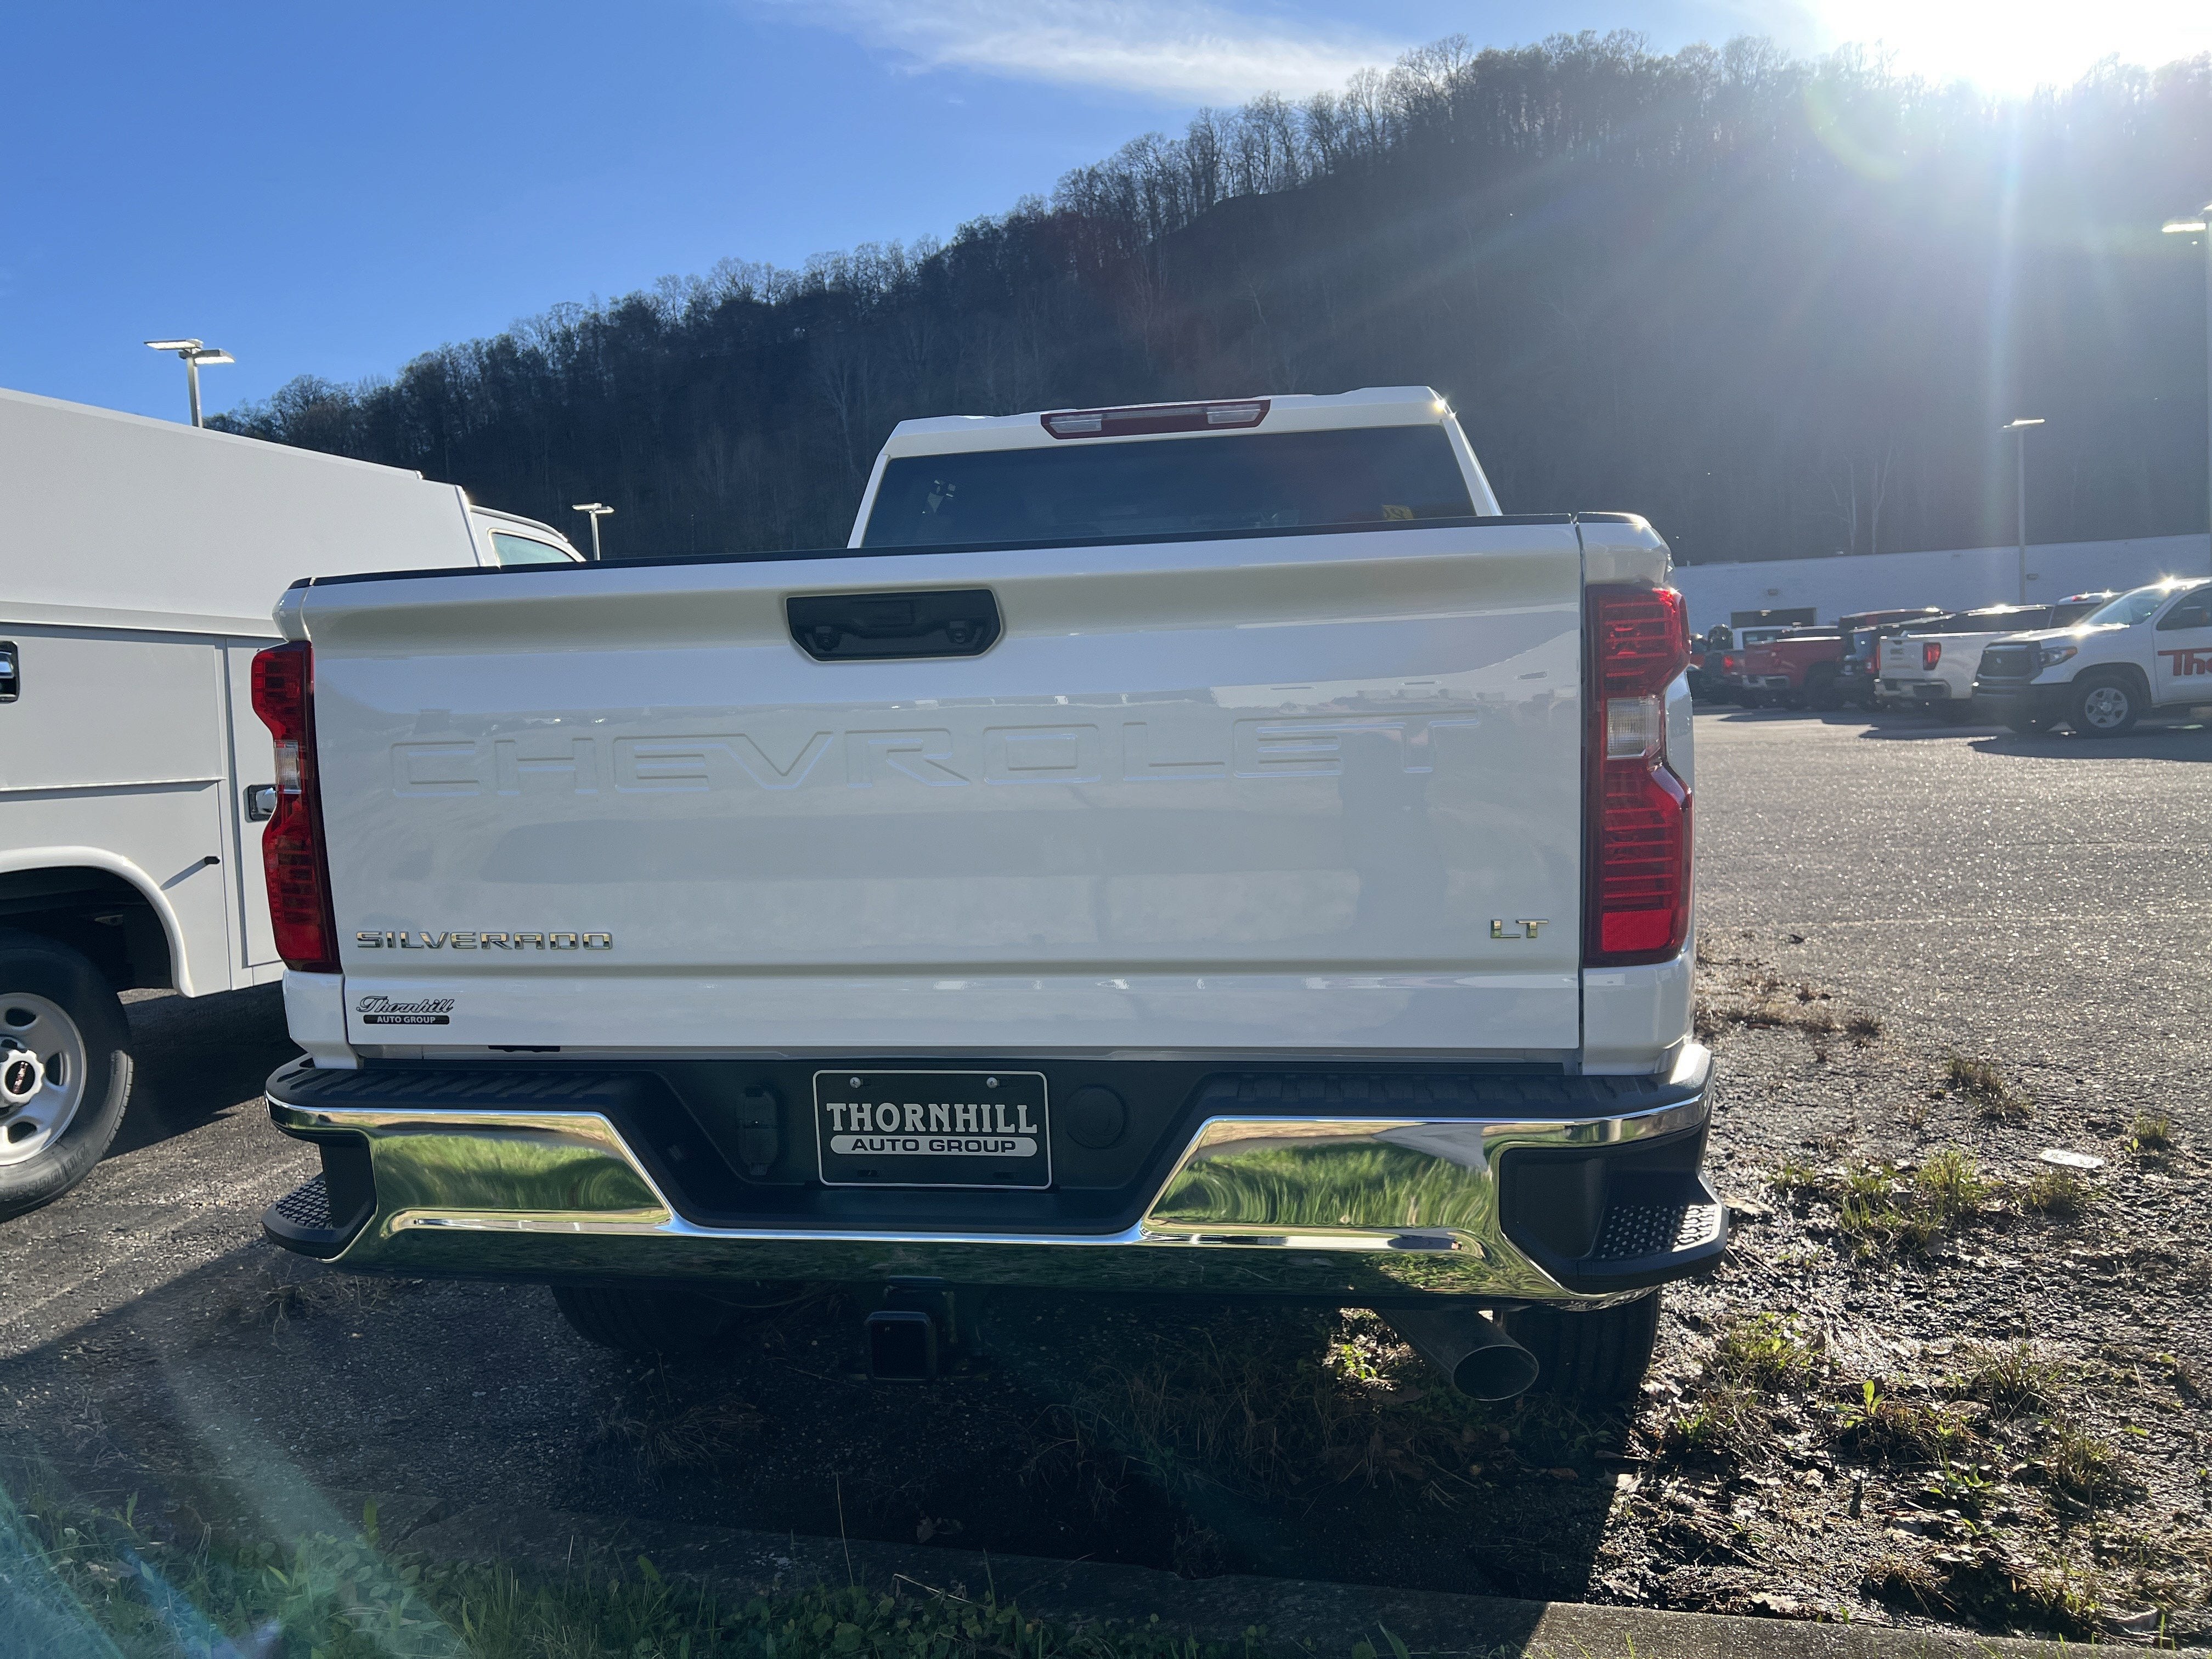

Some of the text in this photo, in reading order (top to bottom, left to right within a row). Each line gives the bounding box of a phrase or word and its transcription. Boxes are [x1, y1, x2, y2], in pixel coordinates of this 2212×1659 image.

[391, 710, 1480, 797] CHEVROLET
[1491, 919, 1549, 938] LT
[356, 931, 612, 950] SILVERADO
[356, 996, 454, 1013] Thornhill
[826, 1102, 1037, 1133] THORNHILL
[851, 1138, 1016, 1153] AUTO GROUP
